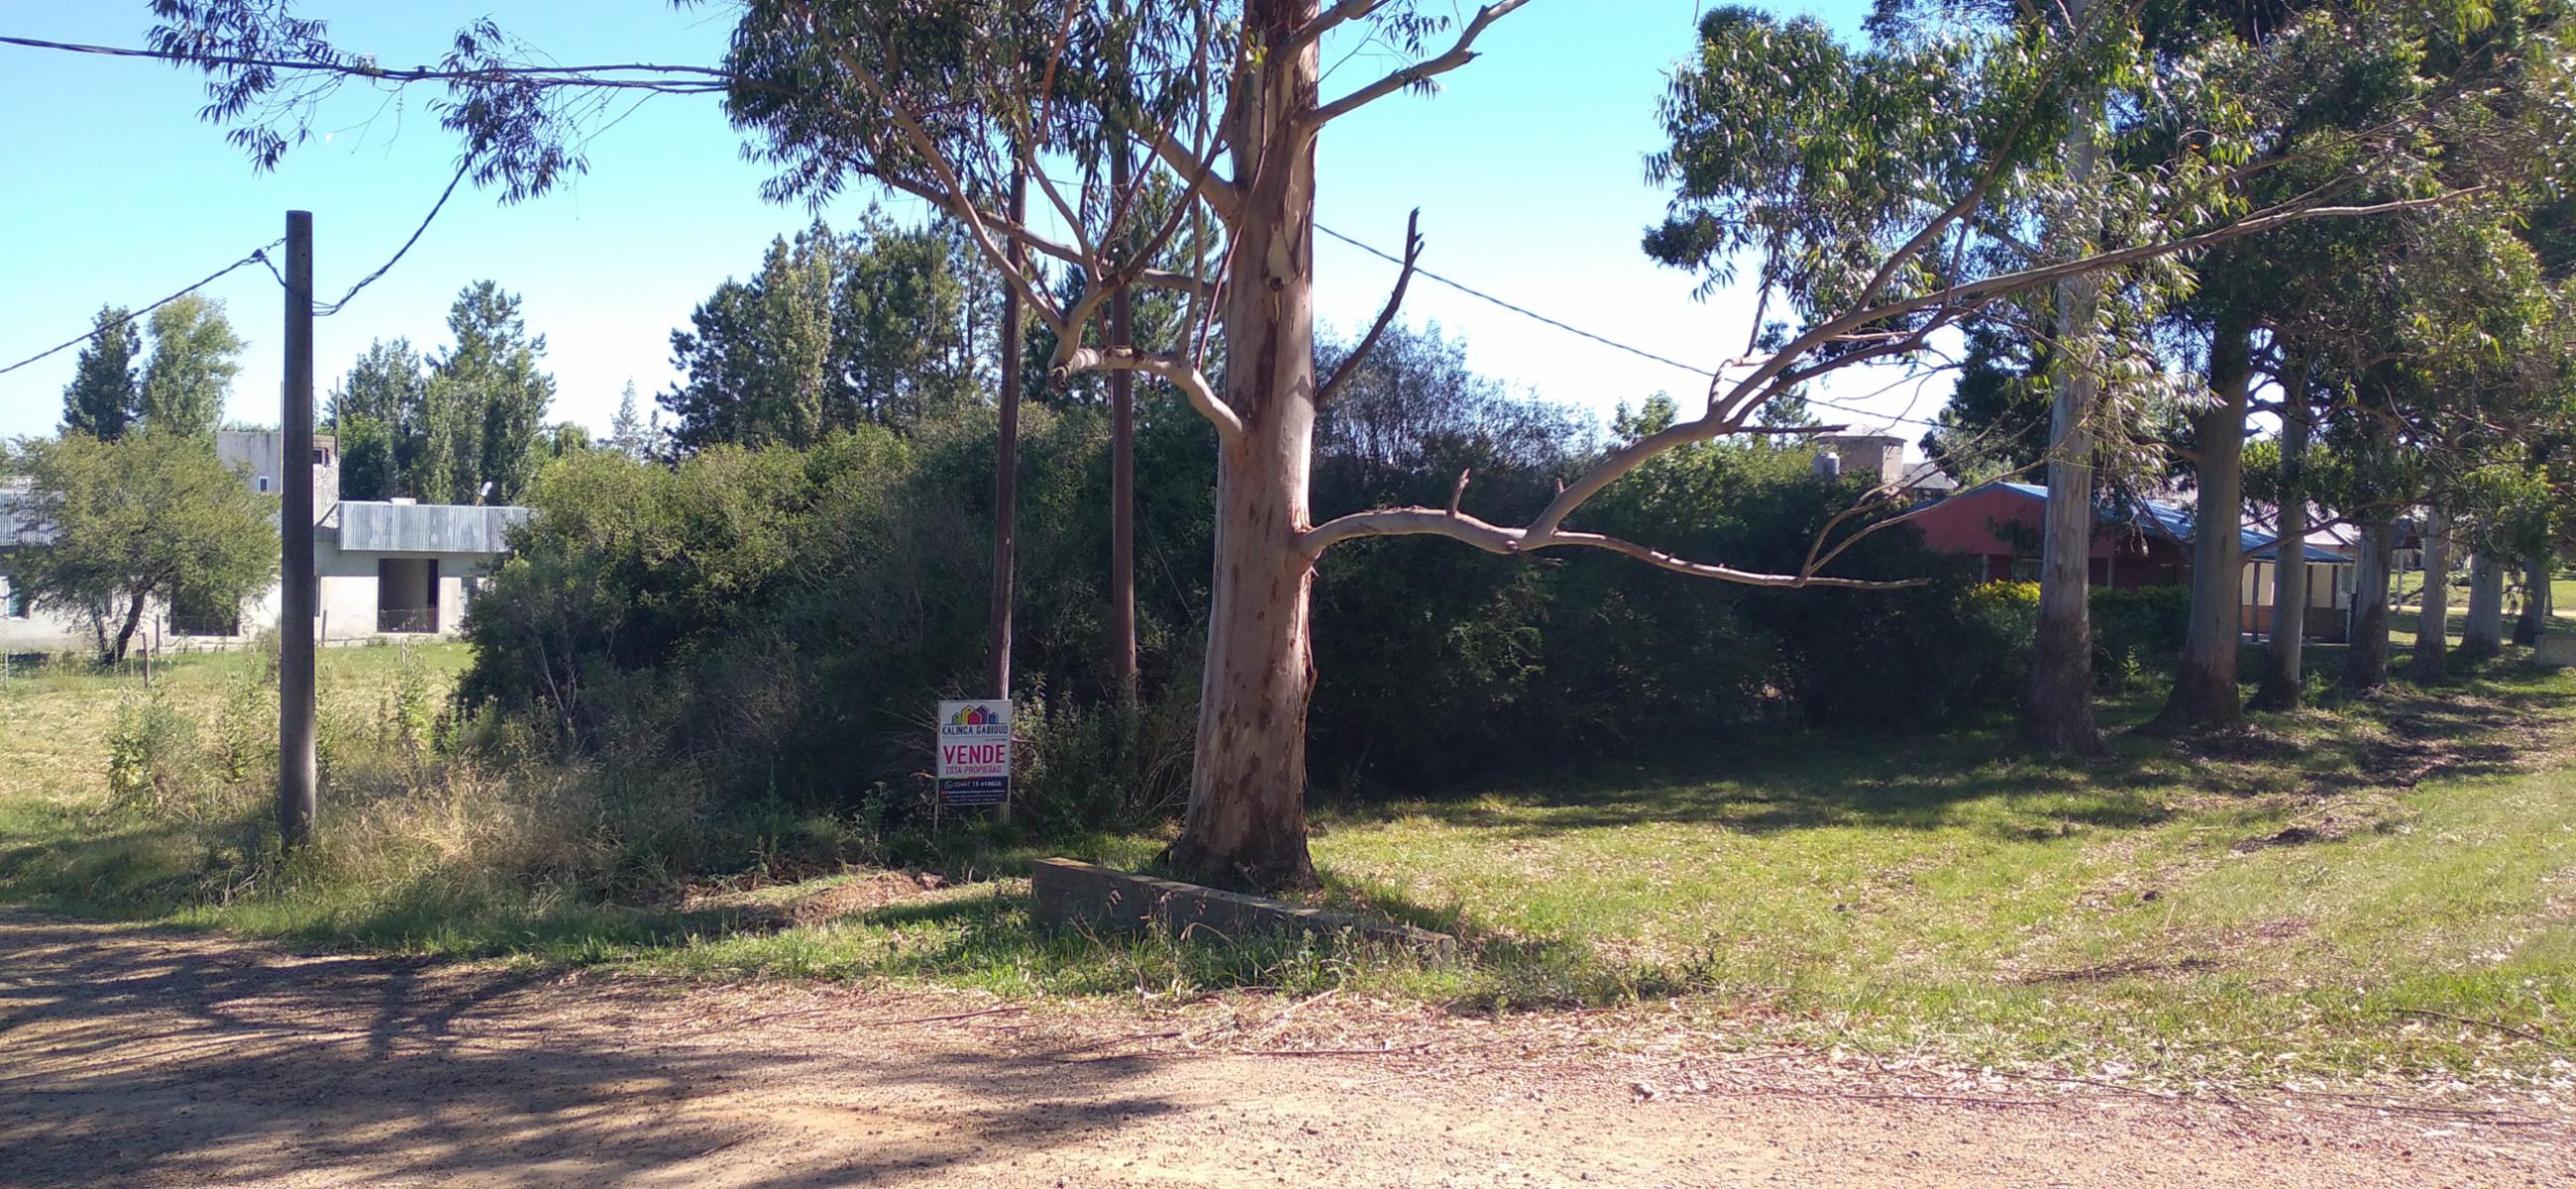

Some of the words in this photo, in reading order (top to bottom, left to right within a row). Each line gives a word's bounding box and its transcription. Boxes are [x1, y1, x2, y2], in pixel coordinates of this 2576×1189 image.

[943, 744, 1006, 764] VENDE
[946, 766, 962, 775] ESTA
[964, 765, 1001, 774] PROPIEDAD
